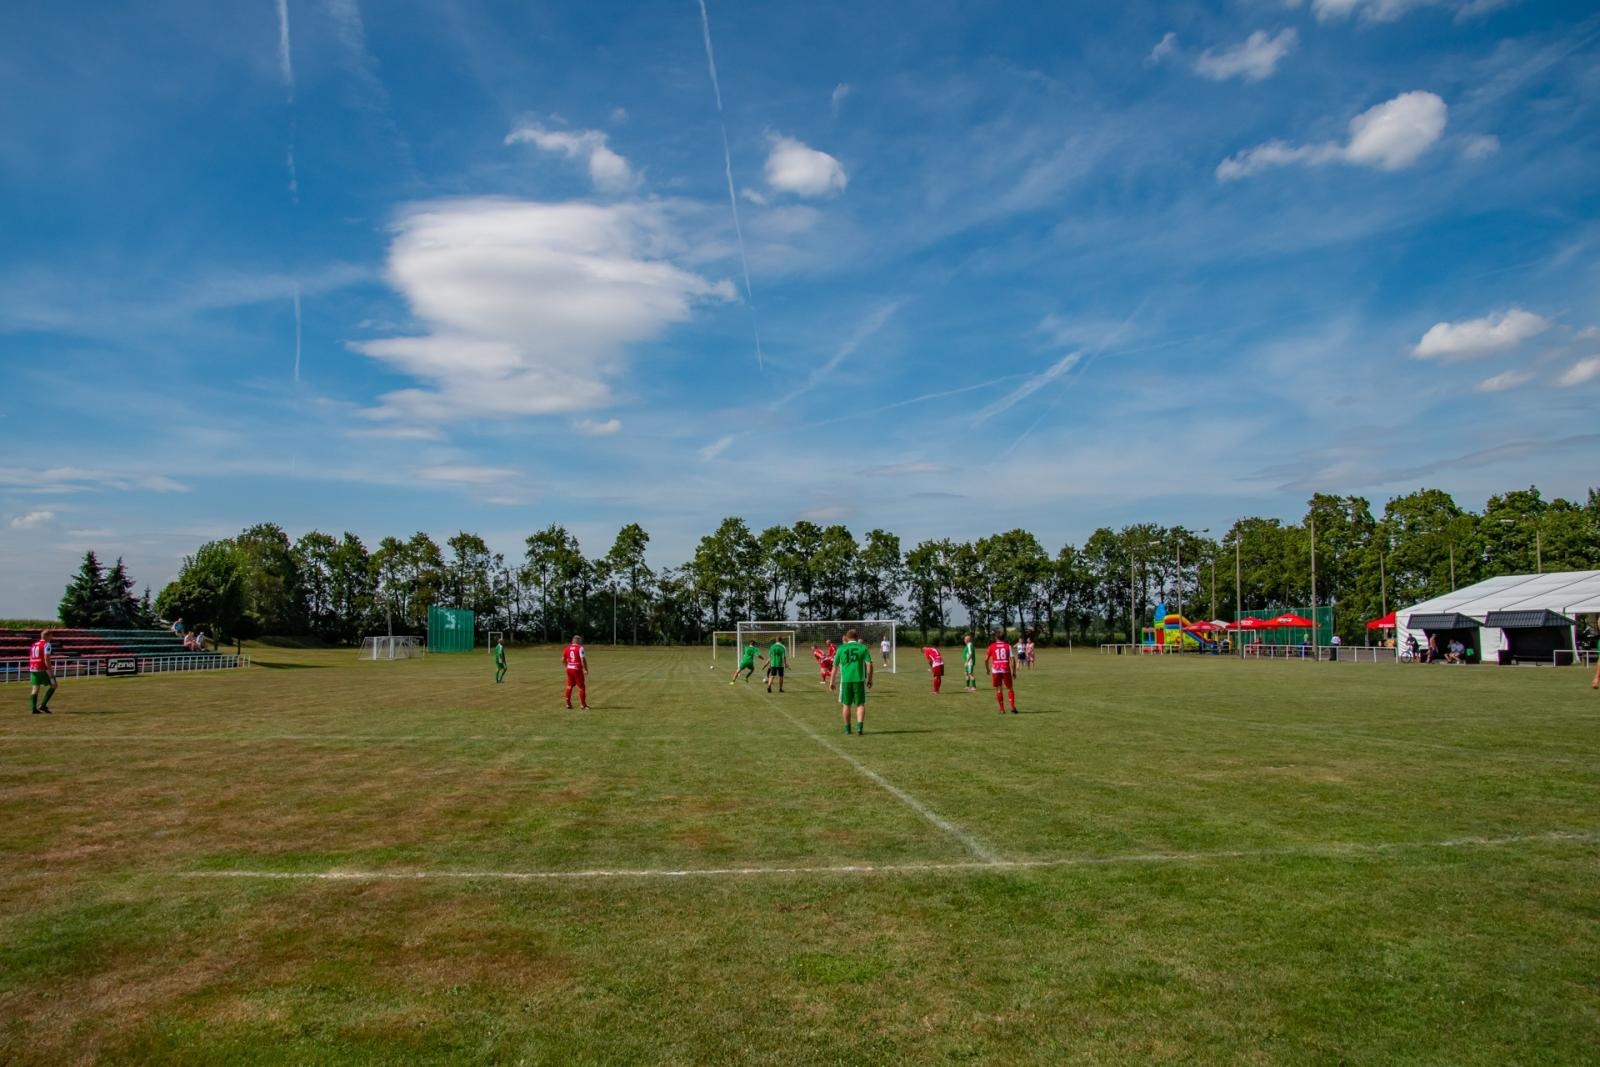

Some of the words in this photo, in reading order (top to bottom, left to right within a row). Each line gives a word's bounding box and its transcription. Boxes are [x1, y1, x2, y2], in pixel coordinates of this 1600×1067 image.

[569, 651, 575, 662] 9
[845, 648, 860, 663] 15
[995, 648, 1006, 660] 18
